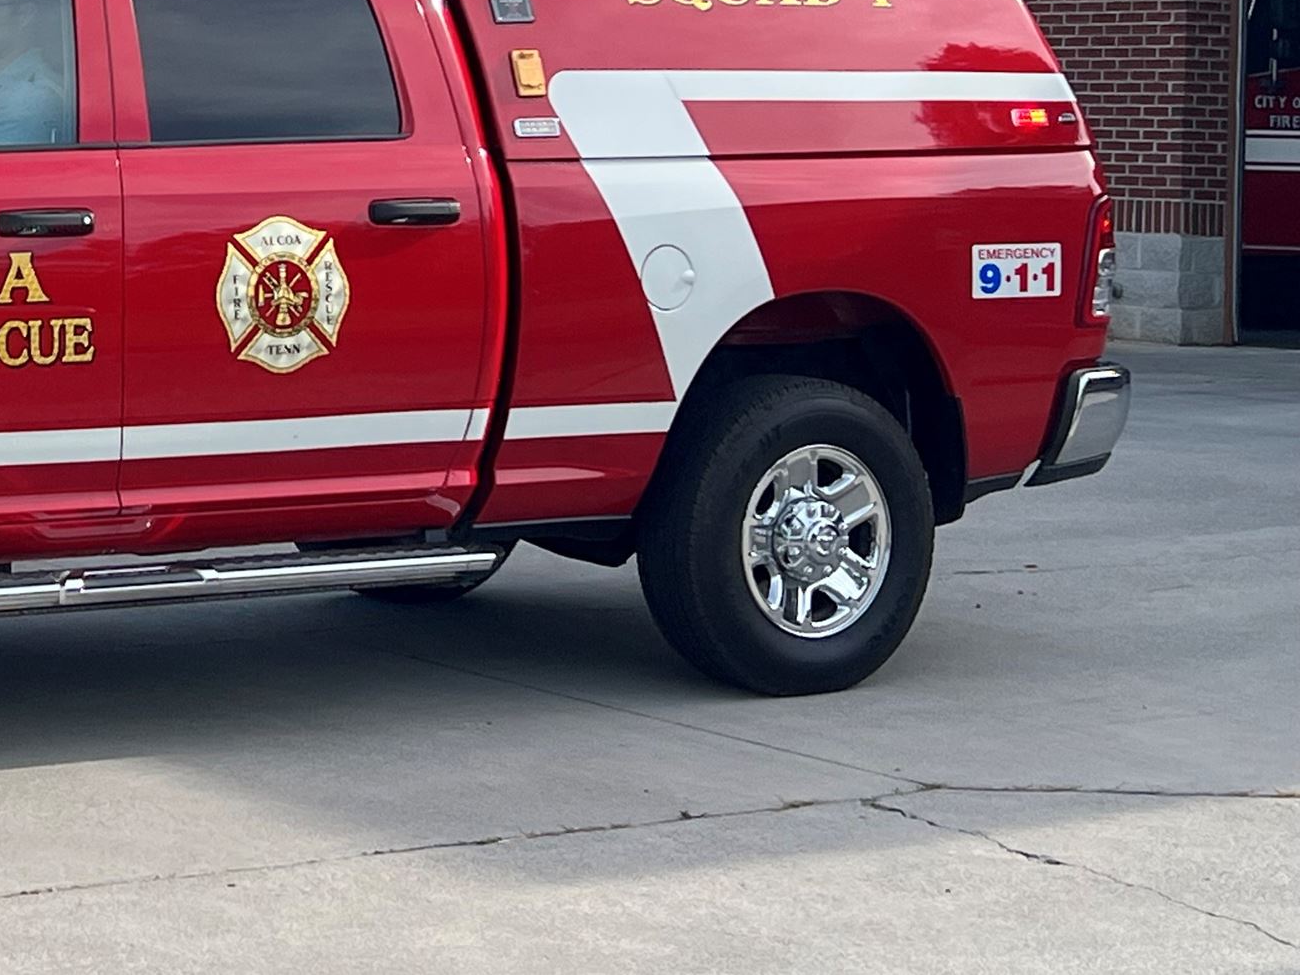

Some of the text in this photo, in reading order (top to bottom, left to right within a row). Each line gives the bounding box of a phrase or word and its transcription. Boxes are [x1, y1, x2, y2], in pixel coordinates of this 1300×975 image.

[1254, 95, 1287, 109] CITY
[1269, 114, 1300, 129] FIRE
[260, 235, 302, 247] ALCOA
[977, 247, 1057, 261] EMERGENCY
[267, 342, 301, 356] TENN
